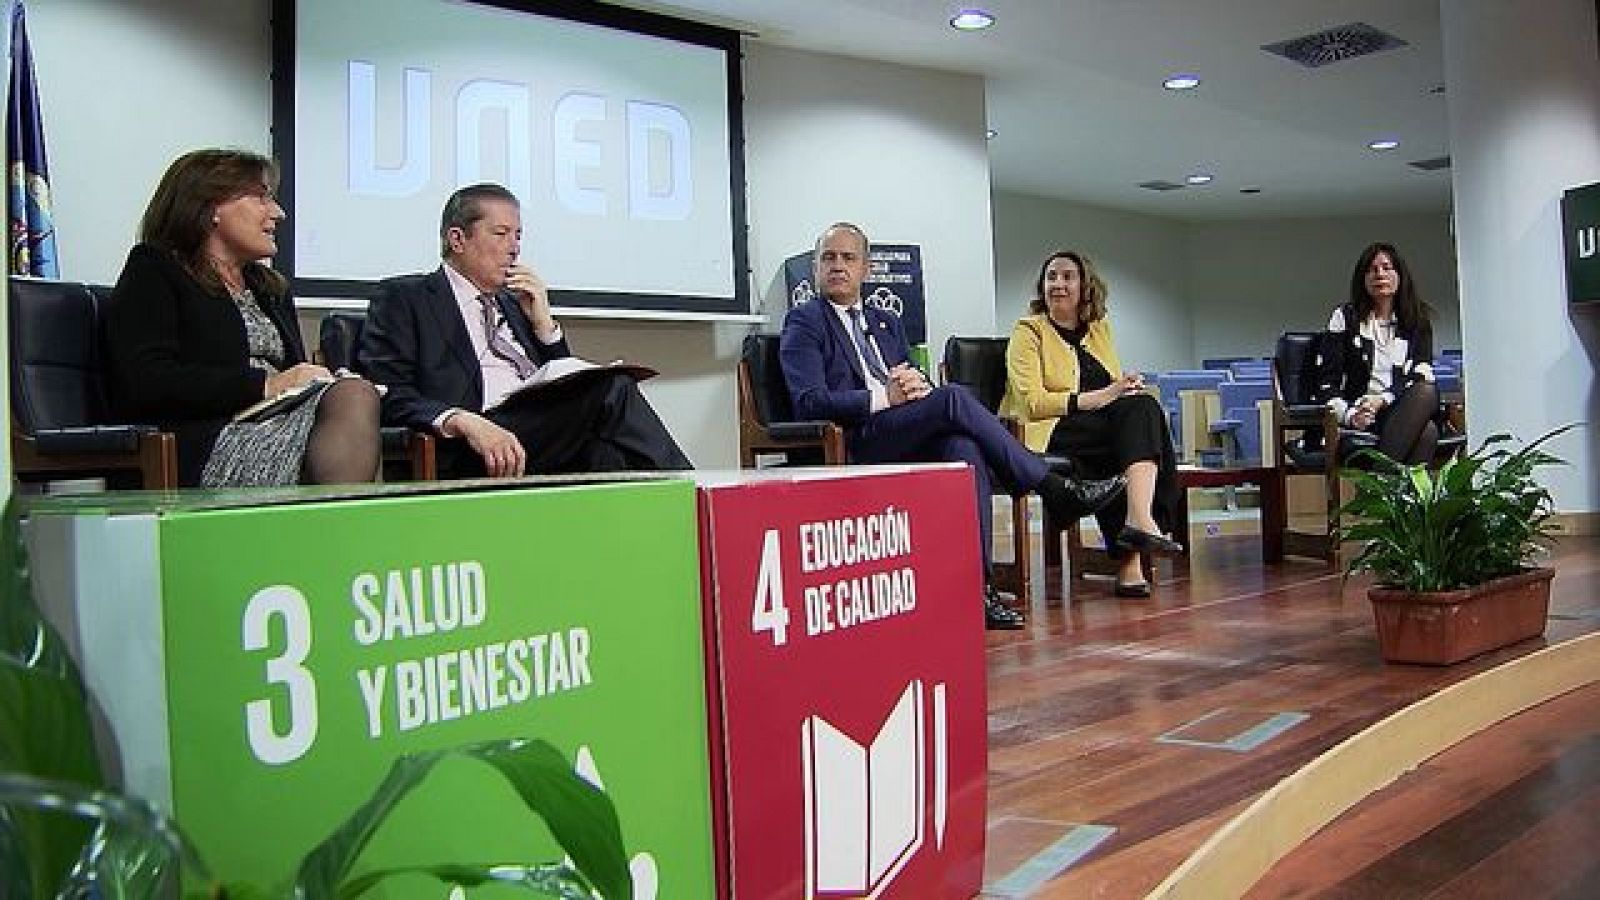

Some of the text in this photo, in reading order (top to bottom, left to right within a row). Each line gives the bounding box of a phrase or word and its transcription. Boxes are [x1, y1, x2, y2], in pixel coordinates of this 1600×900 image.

[347, 60, 694, 220] UNED
[1579, 226, 1600, 258] U
[752, 529, 789, 645] 4
[800, 505, 911, 572] EDUCACIÓN
[352, 561, 486, 645] SALUD
[804, 567, 916, 636] DE CALIDAD
[243, 584, 318, 765] 3
[357, 628, 593, 739] Y BIENESTAR
